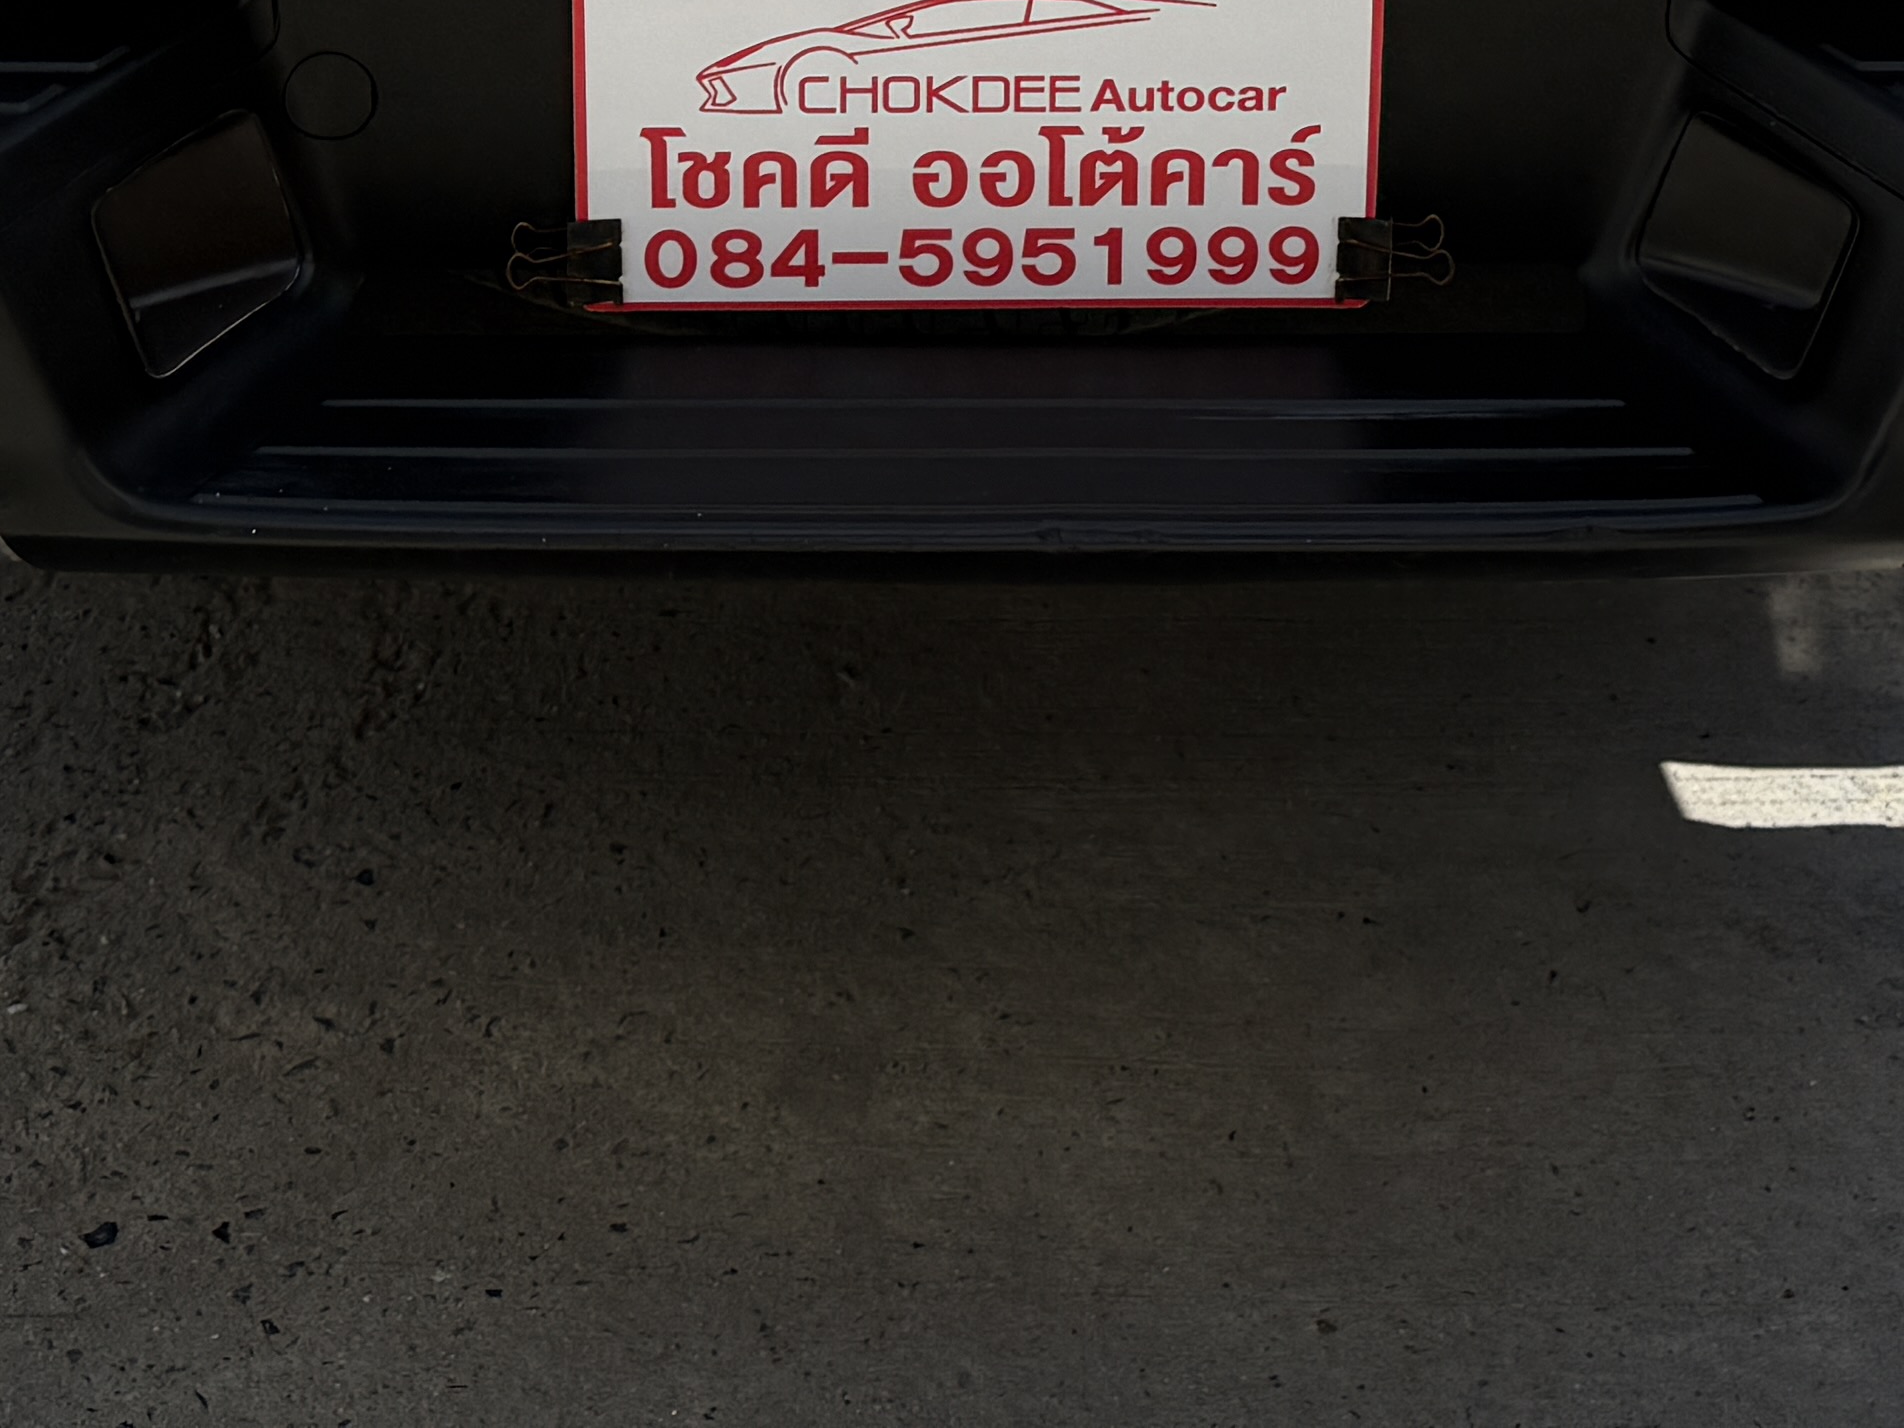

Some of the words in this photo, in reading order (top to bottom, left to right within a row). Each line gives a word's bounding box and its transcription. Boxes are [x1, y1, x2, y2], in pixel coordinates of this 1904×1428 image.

[797, 74, 1082, 115] CHOKDEE
[1091, 77, 1288, 113] Autocar
[639, 125, 871, 210] โชคดี
[912, 123, 1323, 210] ออโต้คาร์
[643, 225, 1321, 290] 084-5951999
